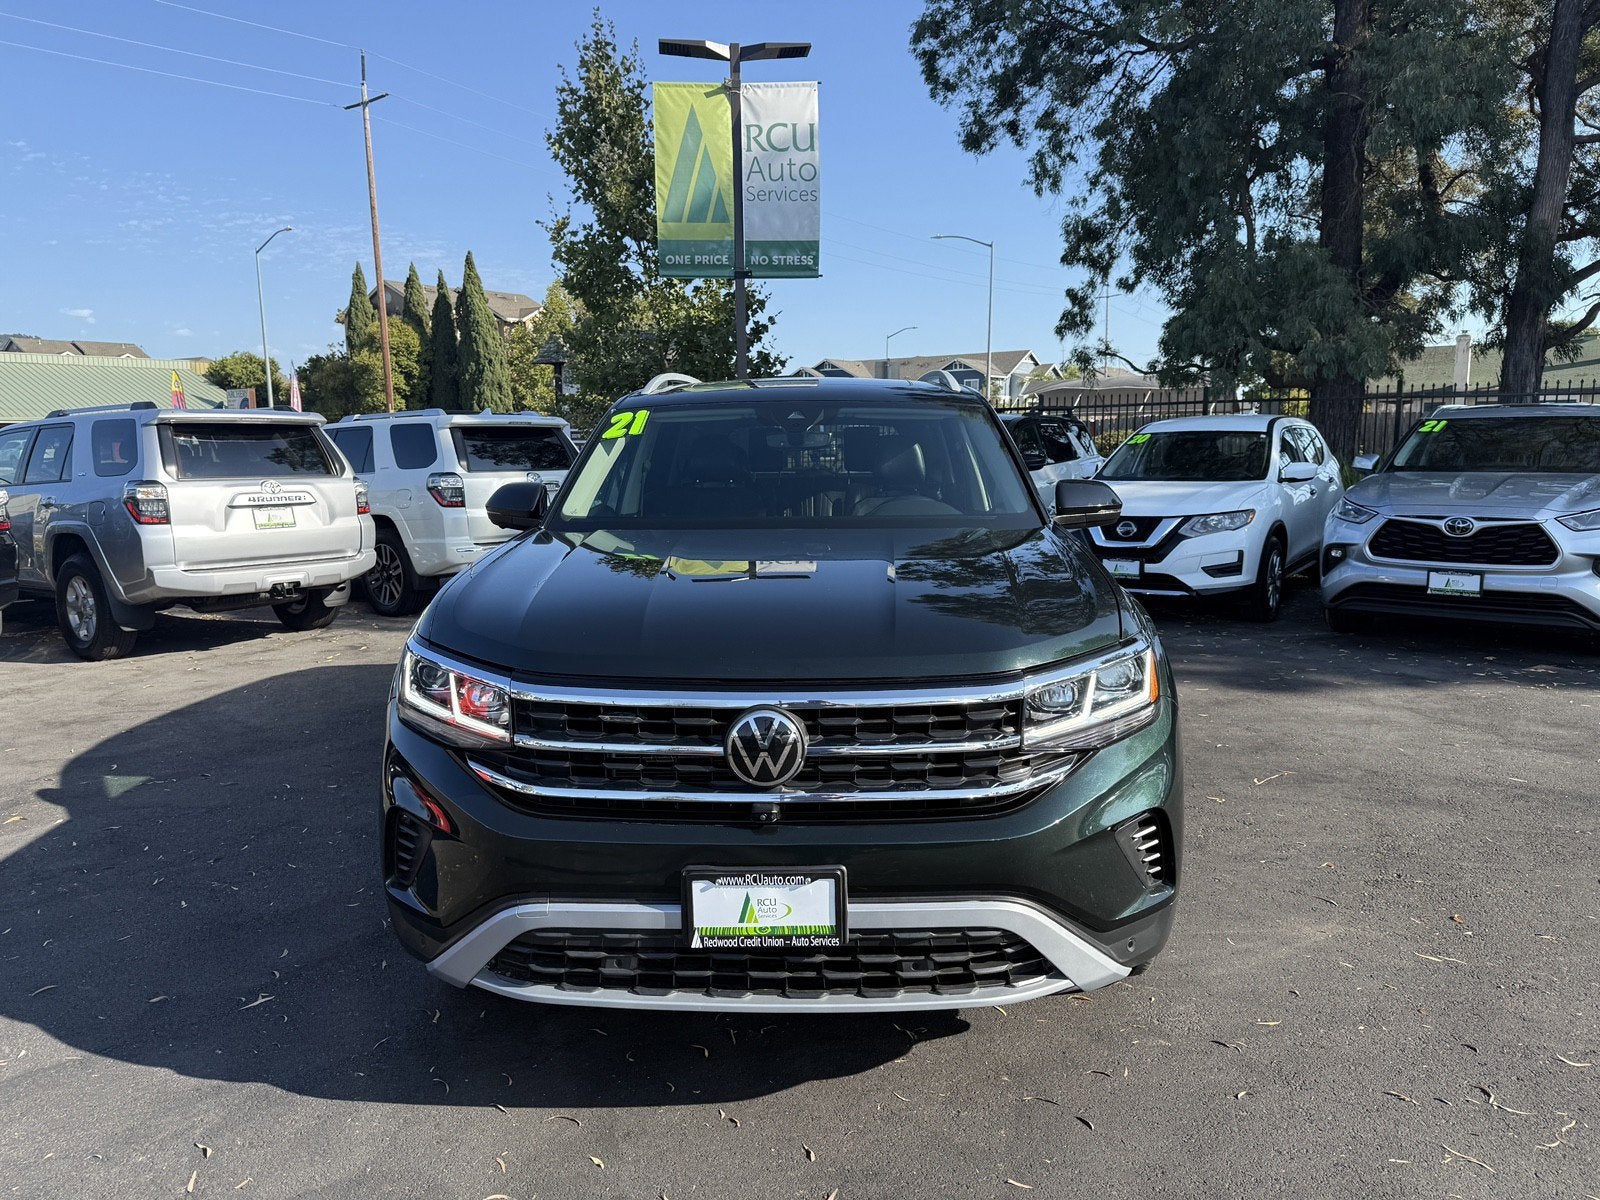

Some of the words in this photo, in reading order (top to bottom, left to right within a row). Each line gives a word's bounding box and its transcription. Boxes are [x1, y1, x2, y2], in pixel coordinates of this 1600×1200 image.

[745, 122, 816, 153] RCU
[746, 156, 817, 182] Auto
[746, 185, 818, 202] Services
[665, 255, 691, 265] ONE
[694, 255, 729, 265] PRICE
[750, 255, 769, 265] NO
[772, 255, 814, 265] STRESS
[602, 410, 650, 439] 21
[1418, 420, 1448, 432] 21
[1127, 433, 1151, 445] 20
[721, 874, 805, 886] www.RCUauto.com
[757, 898, 777, 907] RCU
[757, 906, 778, 914] Auto
[703, 936, 738, 947] Redwood
[738, 936, 762, 947] Credit
[762, 936, 785, 947] Union
[791, 935, 809, 947] Auto
[810, 935, 840, 946] Services
